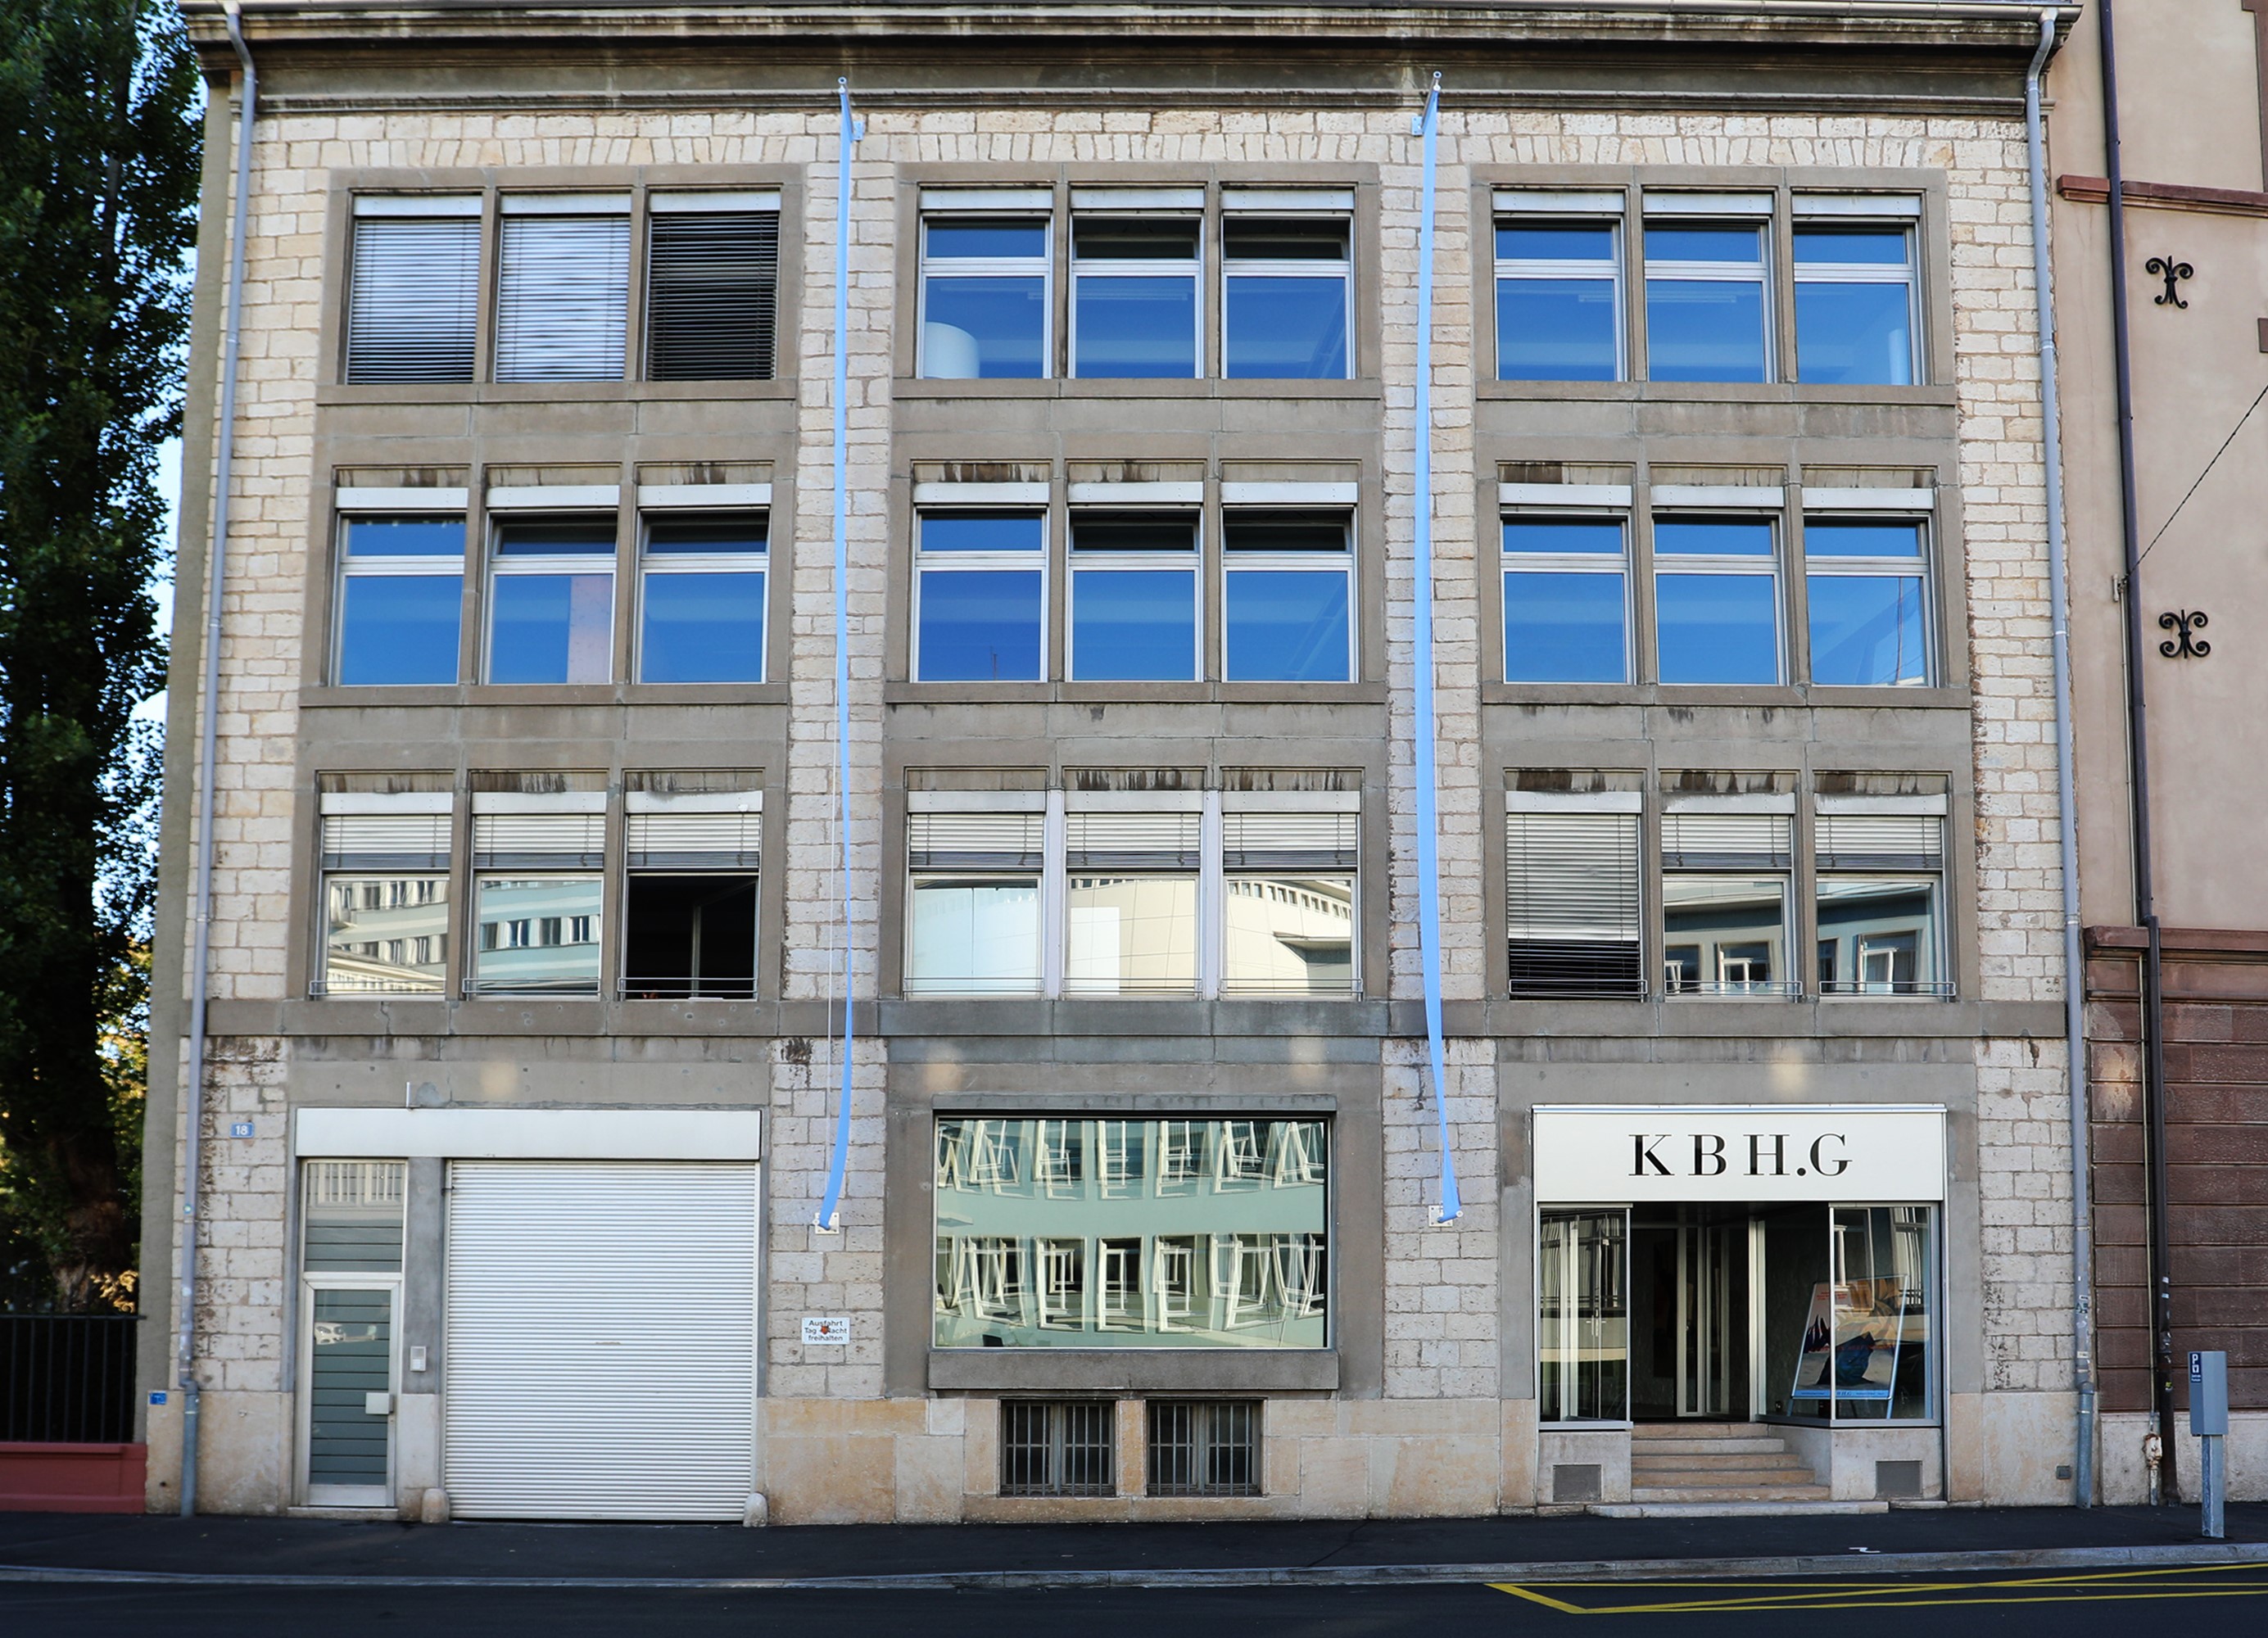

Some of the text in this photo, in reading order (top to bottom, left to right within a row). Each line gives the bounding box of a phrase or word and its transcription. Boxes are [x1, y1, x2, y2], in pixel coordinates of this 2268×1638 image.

[236, 1125, 248, 1135] 18
[1627, 1133, 1853, 1176] KBH.G
[2192, 1354, 2198, 1364] P
